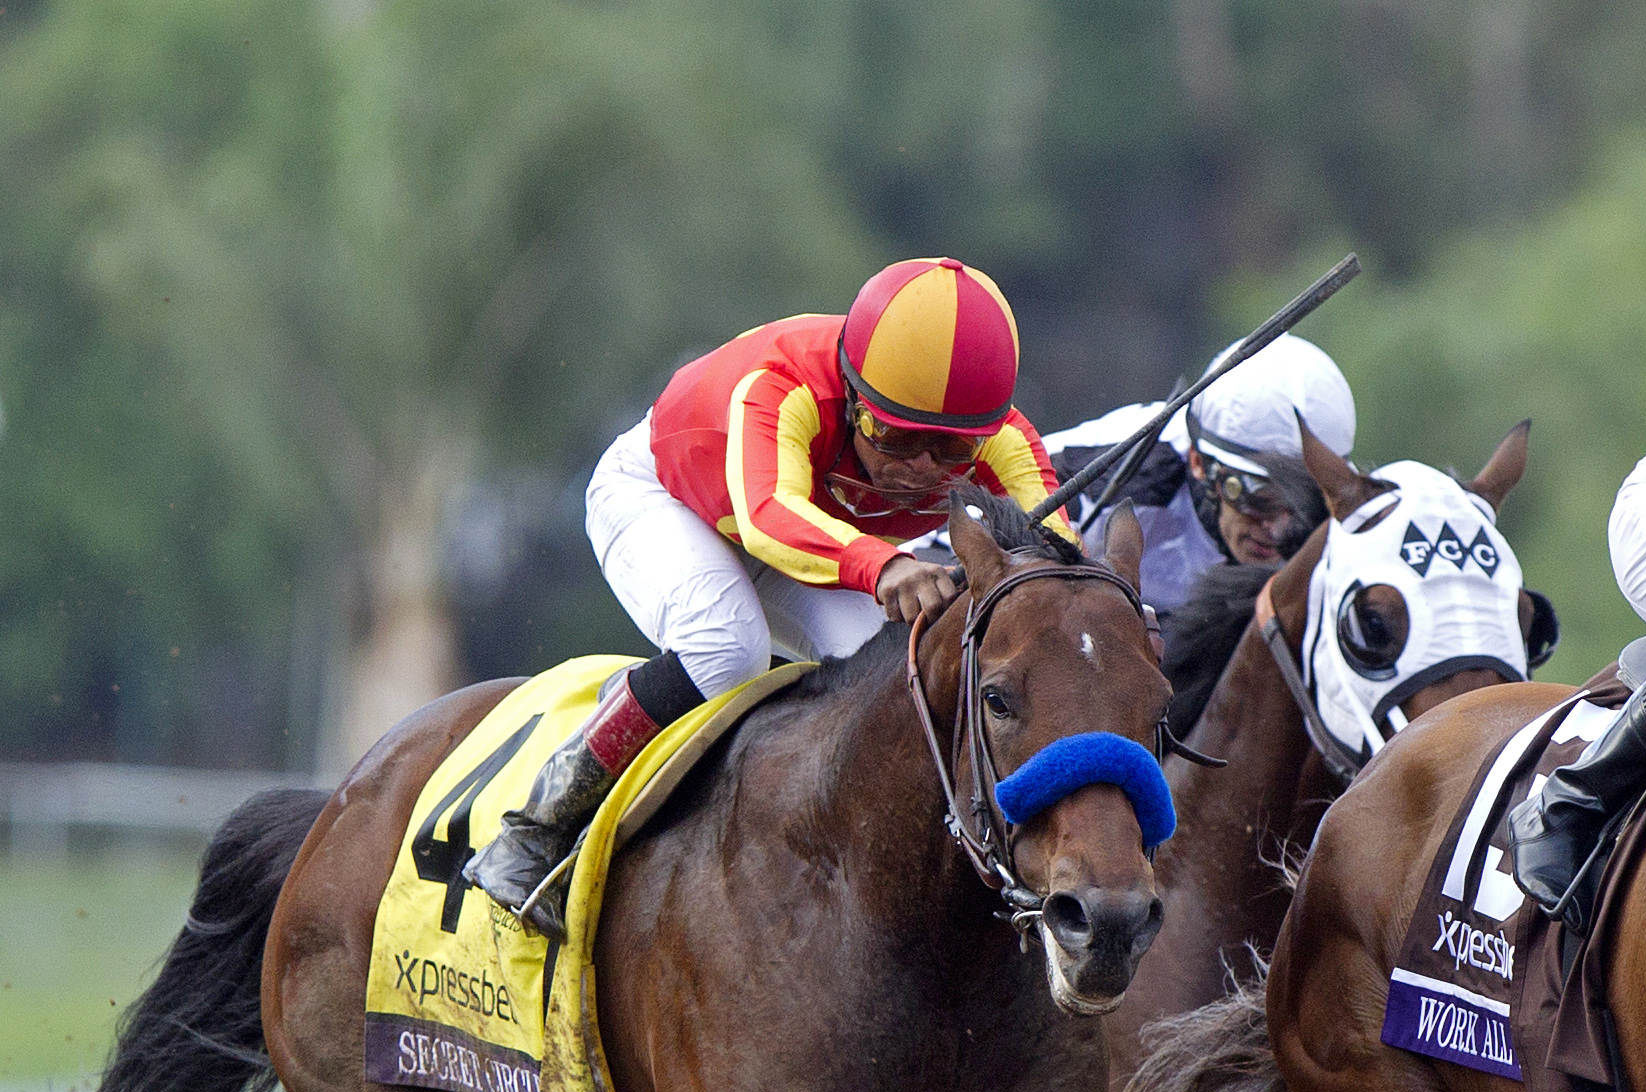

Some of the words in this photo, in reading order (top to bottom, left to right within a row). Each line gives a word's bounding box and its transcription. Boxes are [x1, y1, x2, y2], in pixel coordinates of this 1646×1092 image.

[411, 712, 545, 934] 4
[399, 1031, 483, 1091] SECRET
[1417, 996, 1479, 1055] WORK
[1481, 1018, 1513, 1065] ALL
